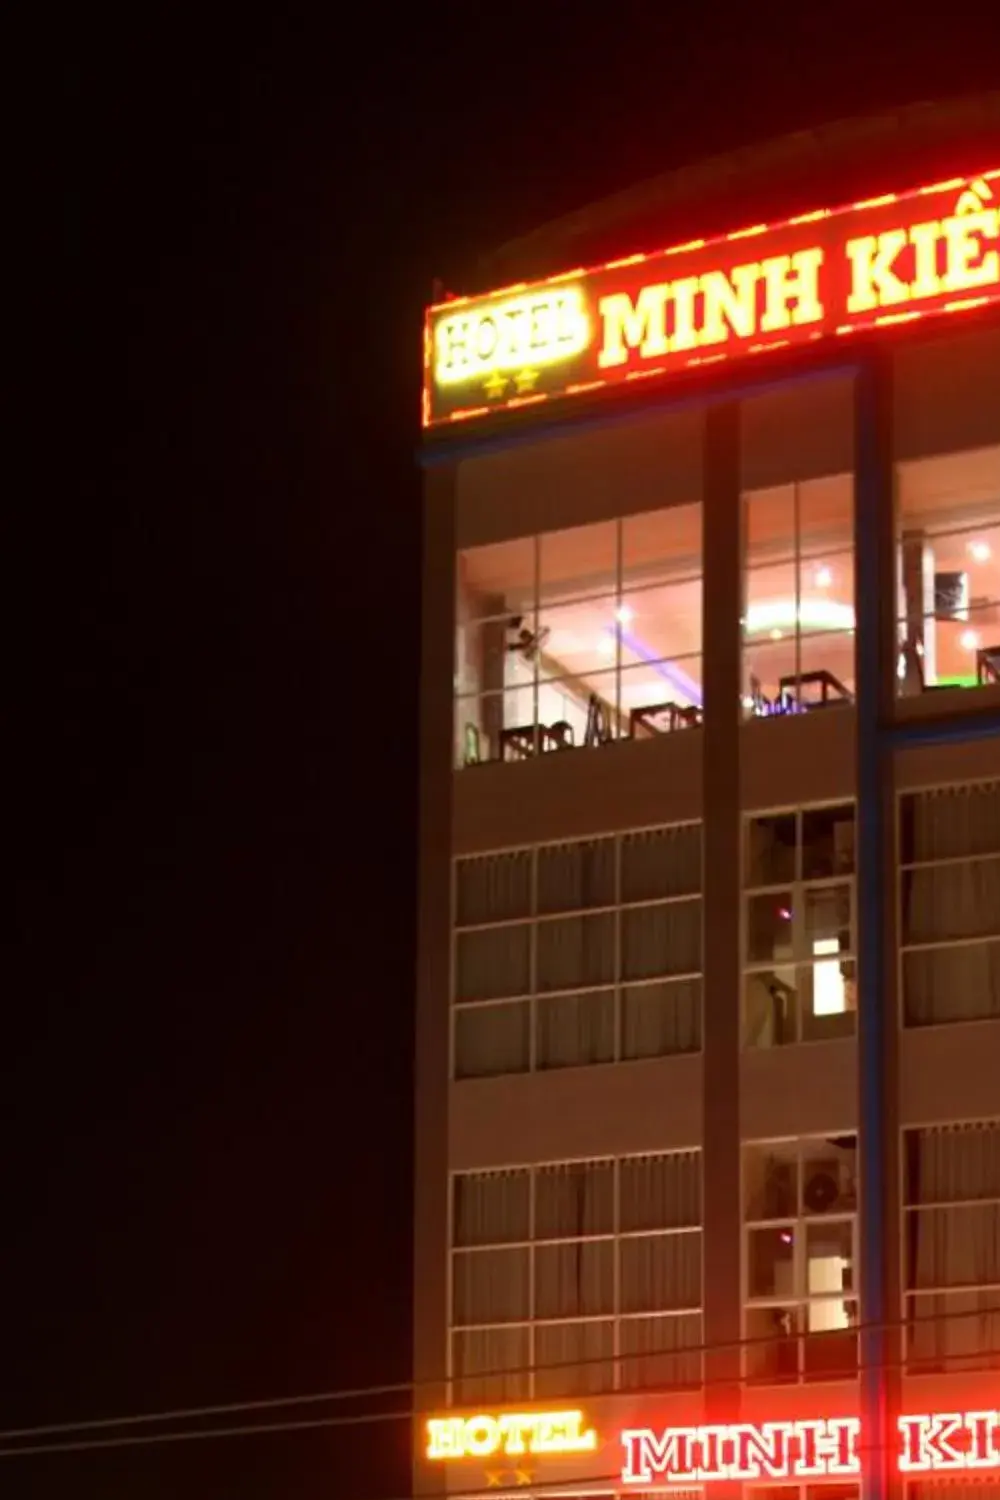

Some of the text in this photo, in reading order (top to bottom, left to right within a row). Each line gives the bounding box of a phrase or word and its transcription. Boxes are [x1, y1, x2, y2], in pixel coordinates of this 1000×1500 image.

[442, 294, 578, 372] HOTEL
[598, 245, 824, 369] MINH
[426, 1410, 596, 1460] HOTEL
[621, 1416, 861, 1484] MINH
